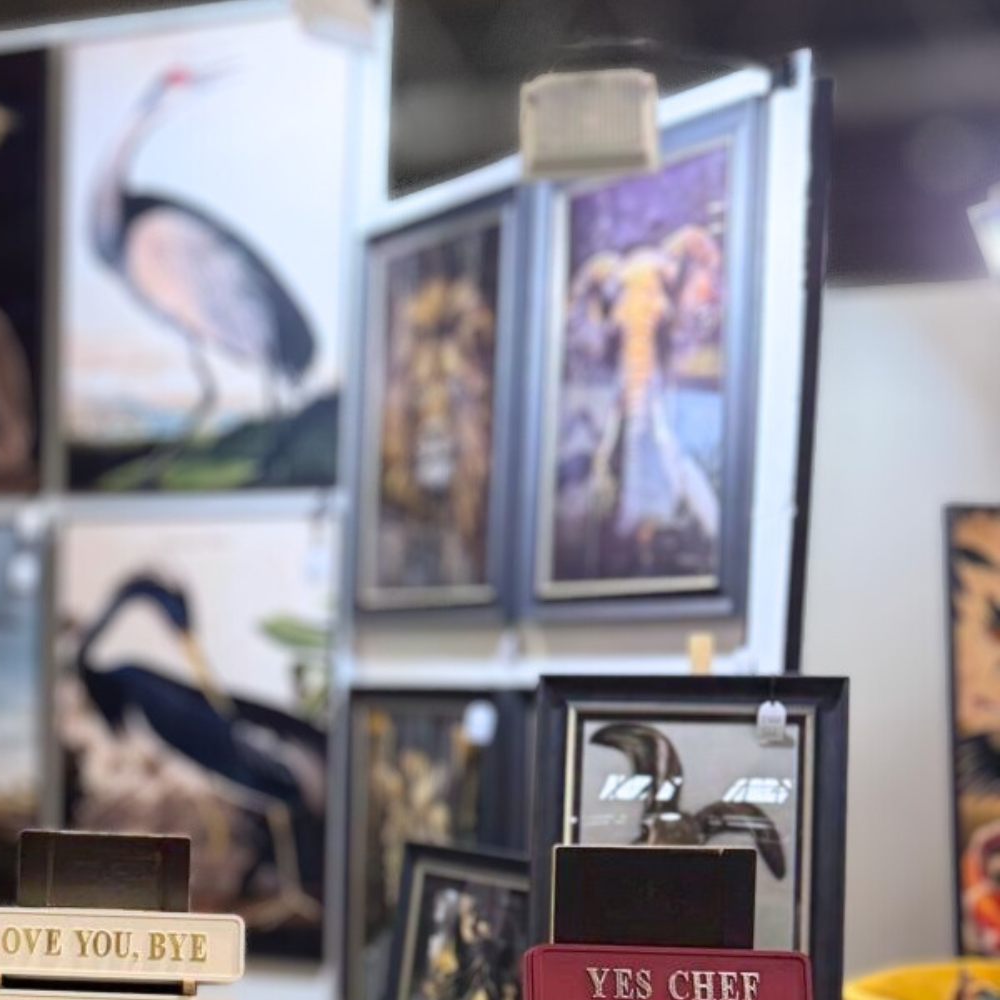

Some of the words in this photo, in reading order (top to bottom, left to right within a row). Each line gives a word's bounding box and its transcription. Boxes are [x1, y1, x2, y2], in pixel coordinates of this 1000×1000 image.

[75, 929, 139, 962] YOU,
[148, 932, 207, 962] BYE
[586, 967, 653, 1000] YES
